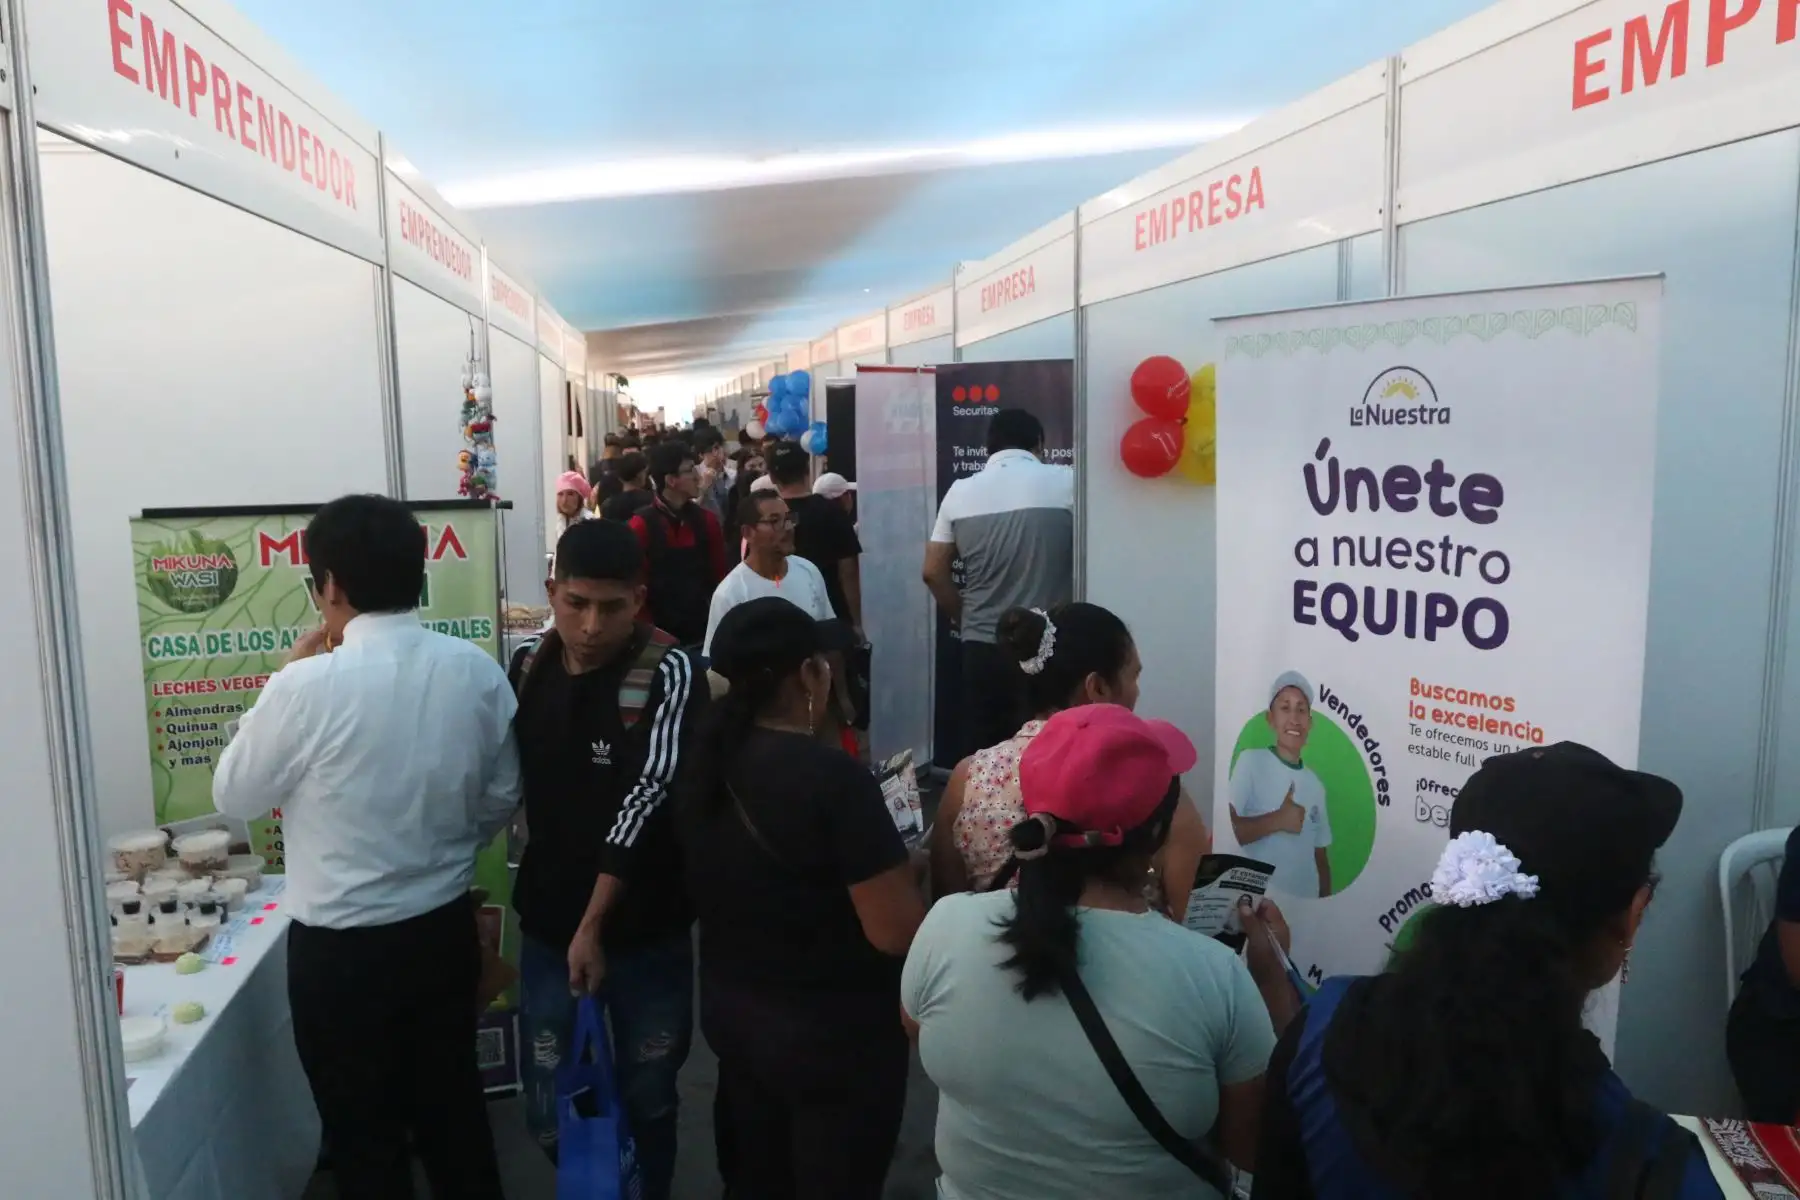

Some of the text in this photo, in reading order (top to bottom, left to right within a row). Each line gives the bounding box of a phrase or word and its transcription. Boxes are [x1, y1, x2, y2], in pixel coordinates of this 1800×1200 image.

[108, 0, 358, 210] EMPRENDEDOR
[1134, 166, 1266, 252] EMPRESA
[399, 200, 472, 281] EMPRENDEDOR
[981, 264, 1036, 313] EMPRESA
[952, 405, 999, 416] Securitas
[1366, 403, 1451, 426] Nuestra
[953, 446, 964, 456] Te
[961, 460, 986, 471] traba
[1303, 437, 1504, 525] Únete
[153, 553, 233, 571] MIKUNA
[1295, 535, 1511, 585] a nuestro
[169, 571, 218, 588] WASI
[1293, 579, 1510, 650] EQUIPO
[148, 635, 200, 658] CASA
[206, 632, 233, 655] DE
[237, 630, 274, 651] LOS
[153, 680, 217, 696] LECHES
[1410, 677, 1516, 712] Buscamos
[165, 703, 243, 717] Almendras
[1409, 700, 1544, 743] la excelencia
[166, 722, 218, 734] Quinua
[1409, 723, 1422, 736] Te
[1425, 728, 1489, 751] ofrecemos
[1494, 743, 1511, 754] un
[1319, 684, 1390, 807] Vendedores
[1408, 743, 1451, 761] estable
[1455, 749, 1475, 767] full
[169, 759, 176, 769] y
